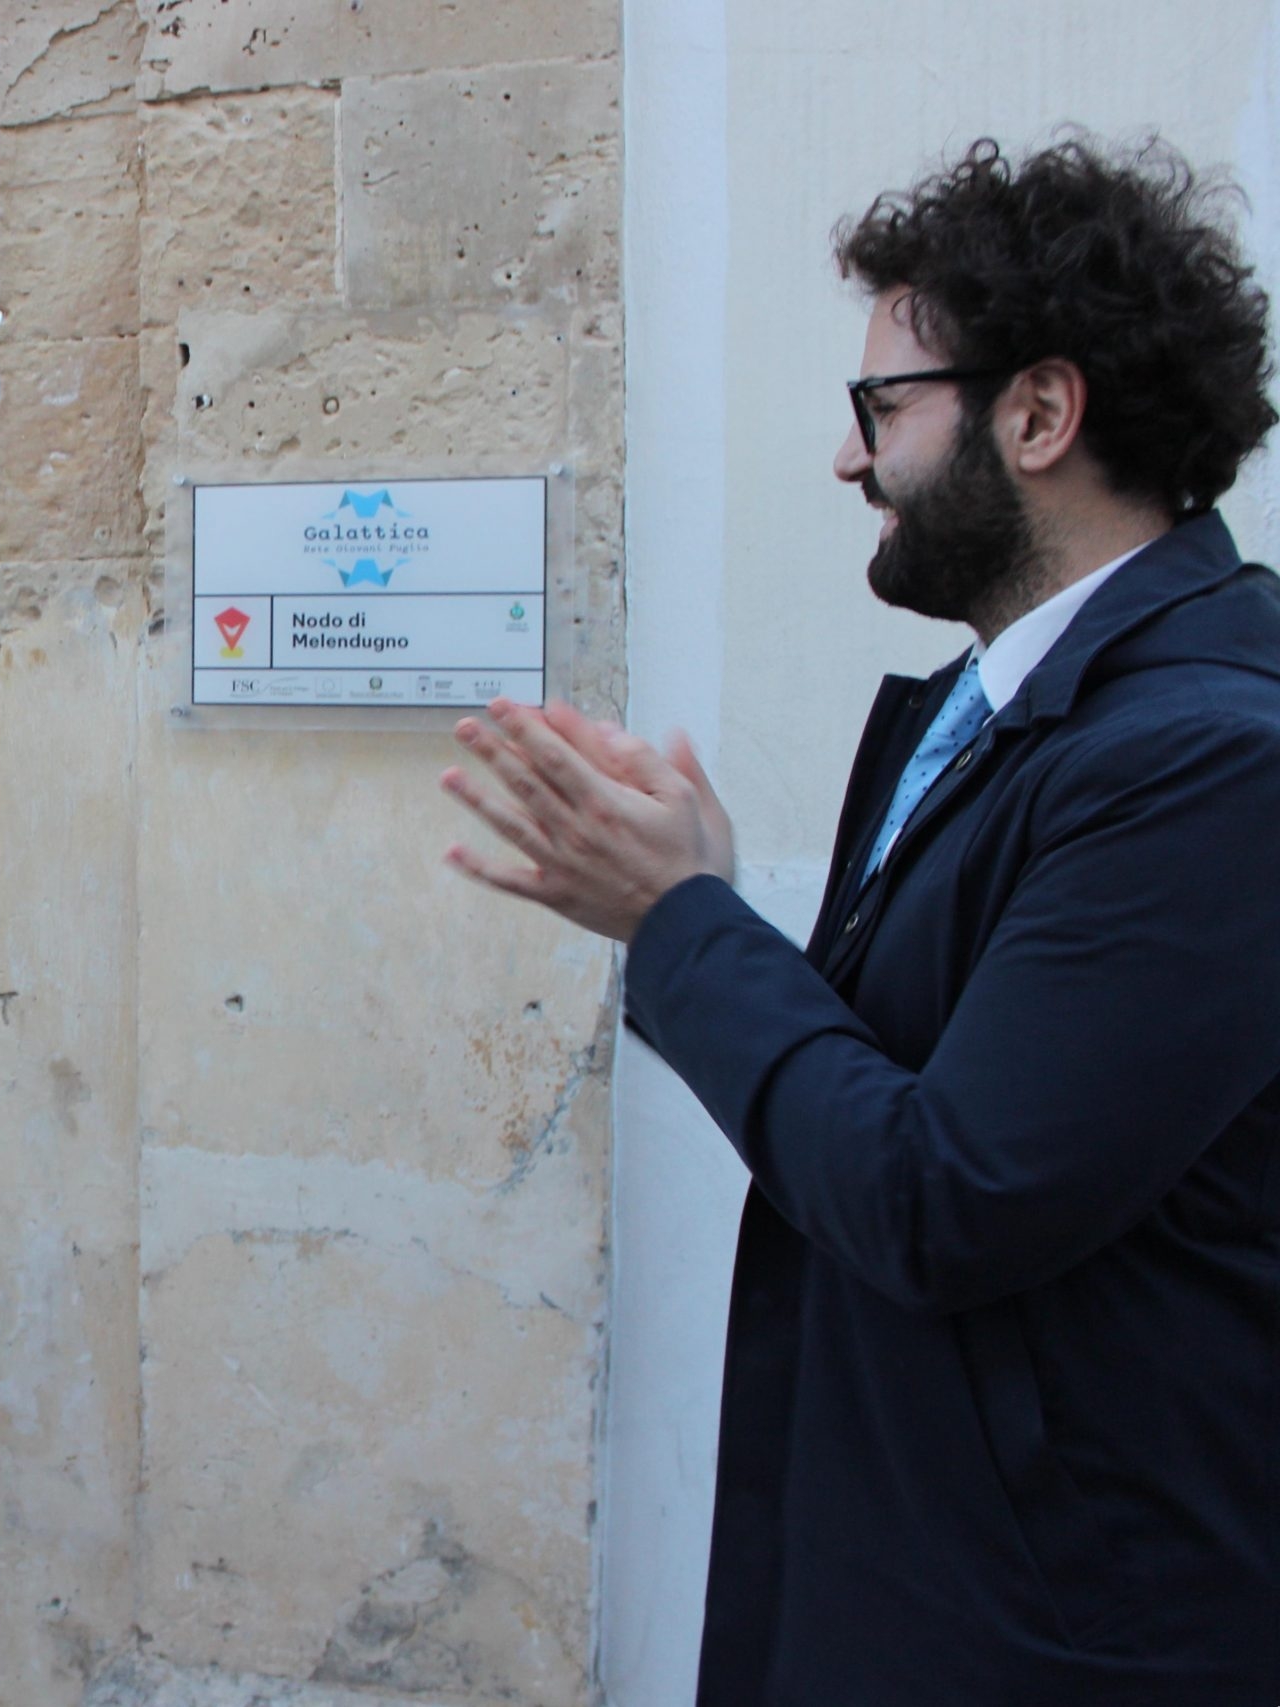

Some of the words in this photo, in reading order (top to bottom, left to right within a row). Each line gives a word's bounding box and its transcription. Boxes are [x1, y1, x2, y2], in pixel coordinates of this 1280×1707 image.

[304, 522, 430, 541] Galattica
[292, 612, 343, 628] Nodo
[348, 611, 366, 628] di
[292, 632, 409, 653] Melendugno
[232, 679, 260, 693] FSC
